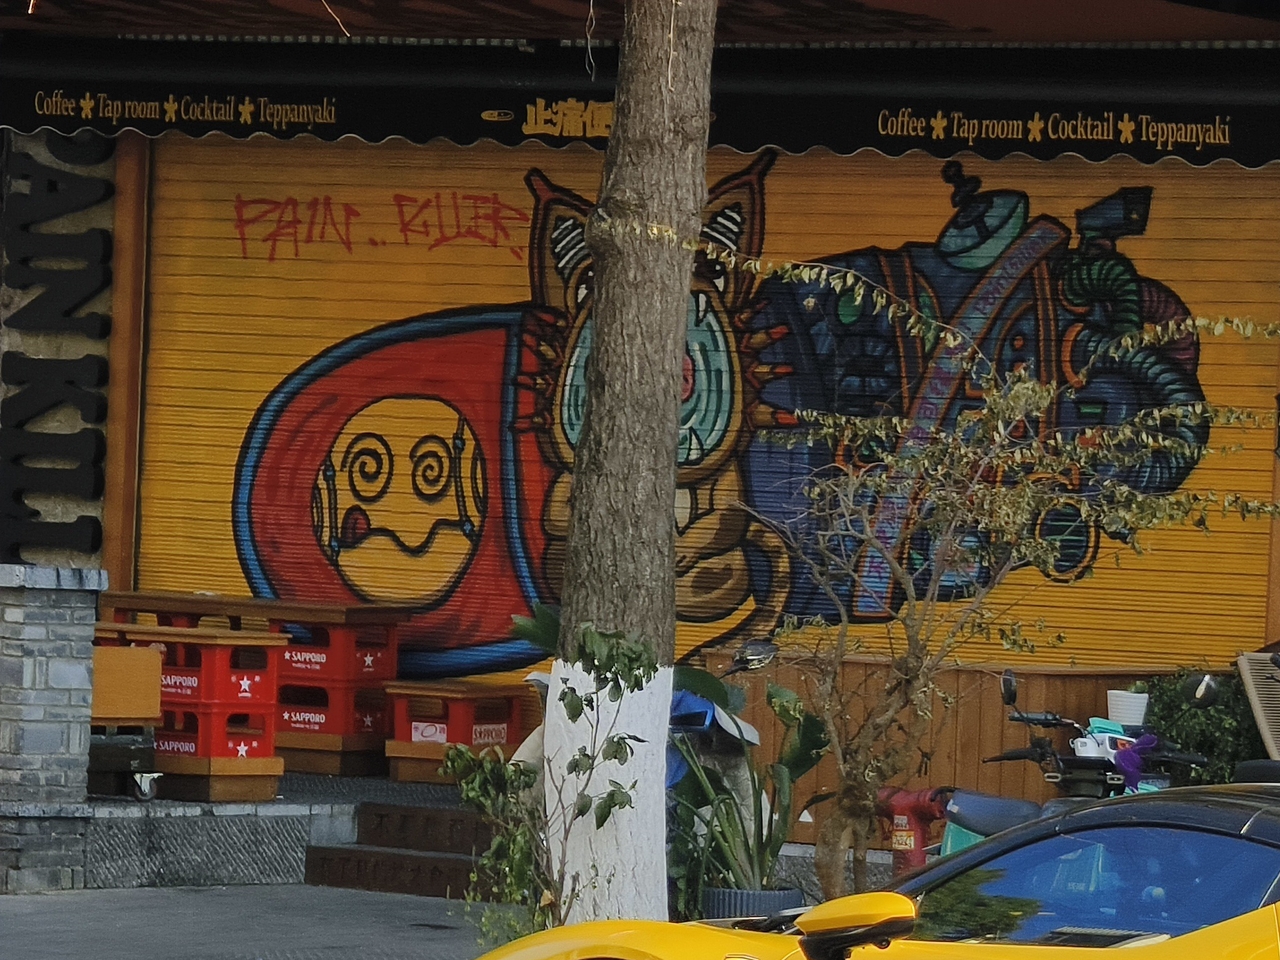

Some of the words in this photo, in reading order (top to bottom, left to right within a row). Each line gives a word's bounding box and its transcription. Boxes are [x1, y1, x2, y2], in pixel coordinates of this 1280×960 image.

[34, 90, 76, 116] Coffee
[97, 93, 122, 125] Tap
[124, 98, 160, 120] room
[180, 95, 235, 122] Cocktail
[257, 96, 337, 130] Teppanyaki
[878, 108, 926, 137] Coffee
[950, 111, 979, 146] Tap
[980, 117, 1023, 140] room
[1047, 111, 1114, 141] Cocktail
[1138, 114, 1231, 151] Teppanyaki
[291, 651, 327, 663] SAPPORO
[161, 674, 199, 688] SAPPORO
[290, 711, 326, 723] SAPPORO
[158, 739, 196, 754] SAPPORO
